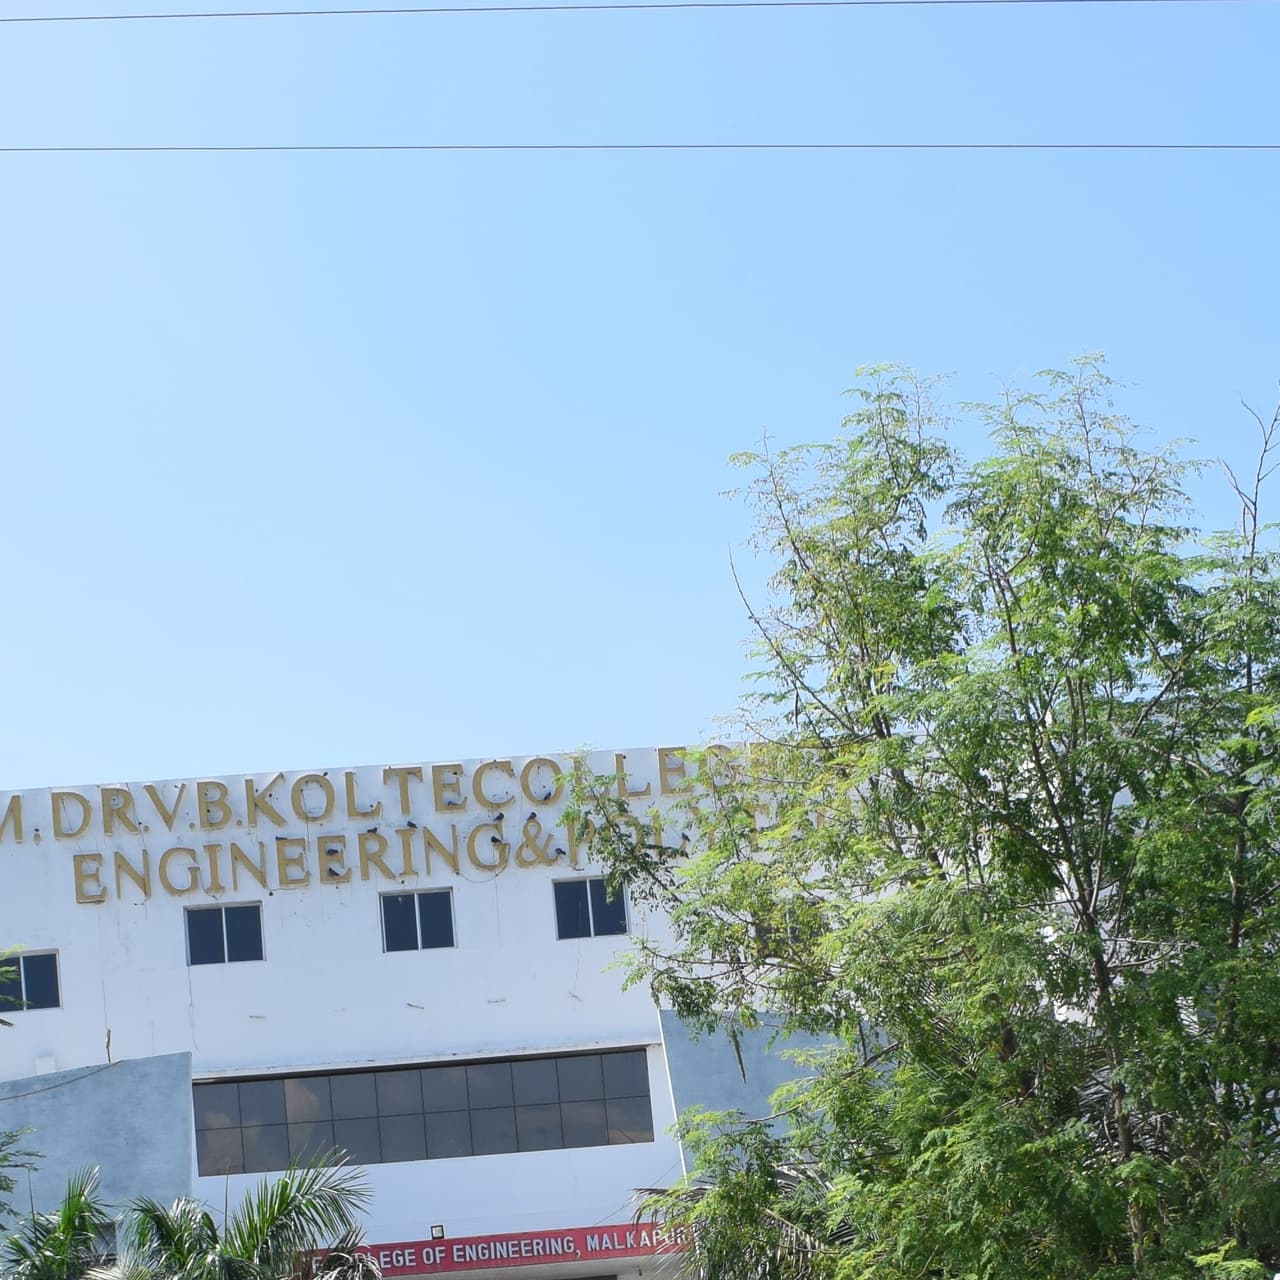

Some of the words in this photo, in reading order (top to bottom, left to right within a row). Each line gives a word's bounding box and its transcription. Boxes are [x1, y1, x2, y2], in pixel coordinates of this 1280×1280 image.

[73, 820, 512, 904] ENGINEERING
[422, 1246, 446, 1266] OF
[453, 1236, 581, 1262] ENGINEERING,
